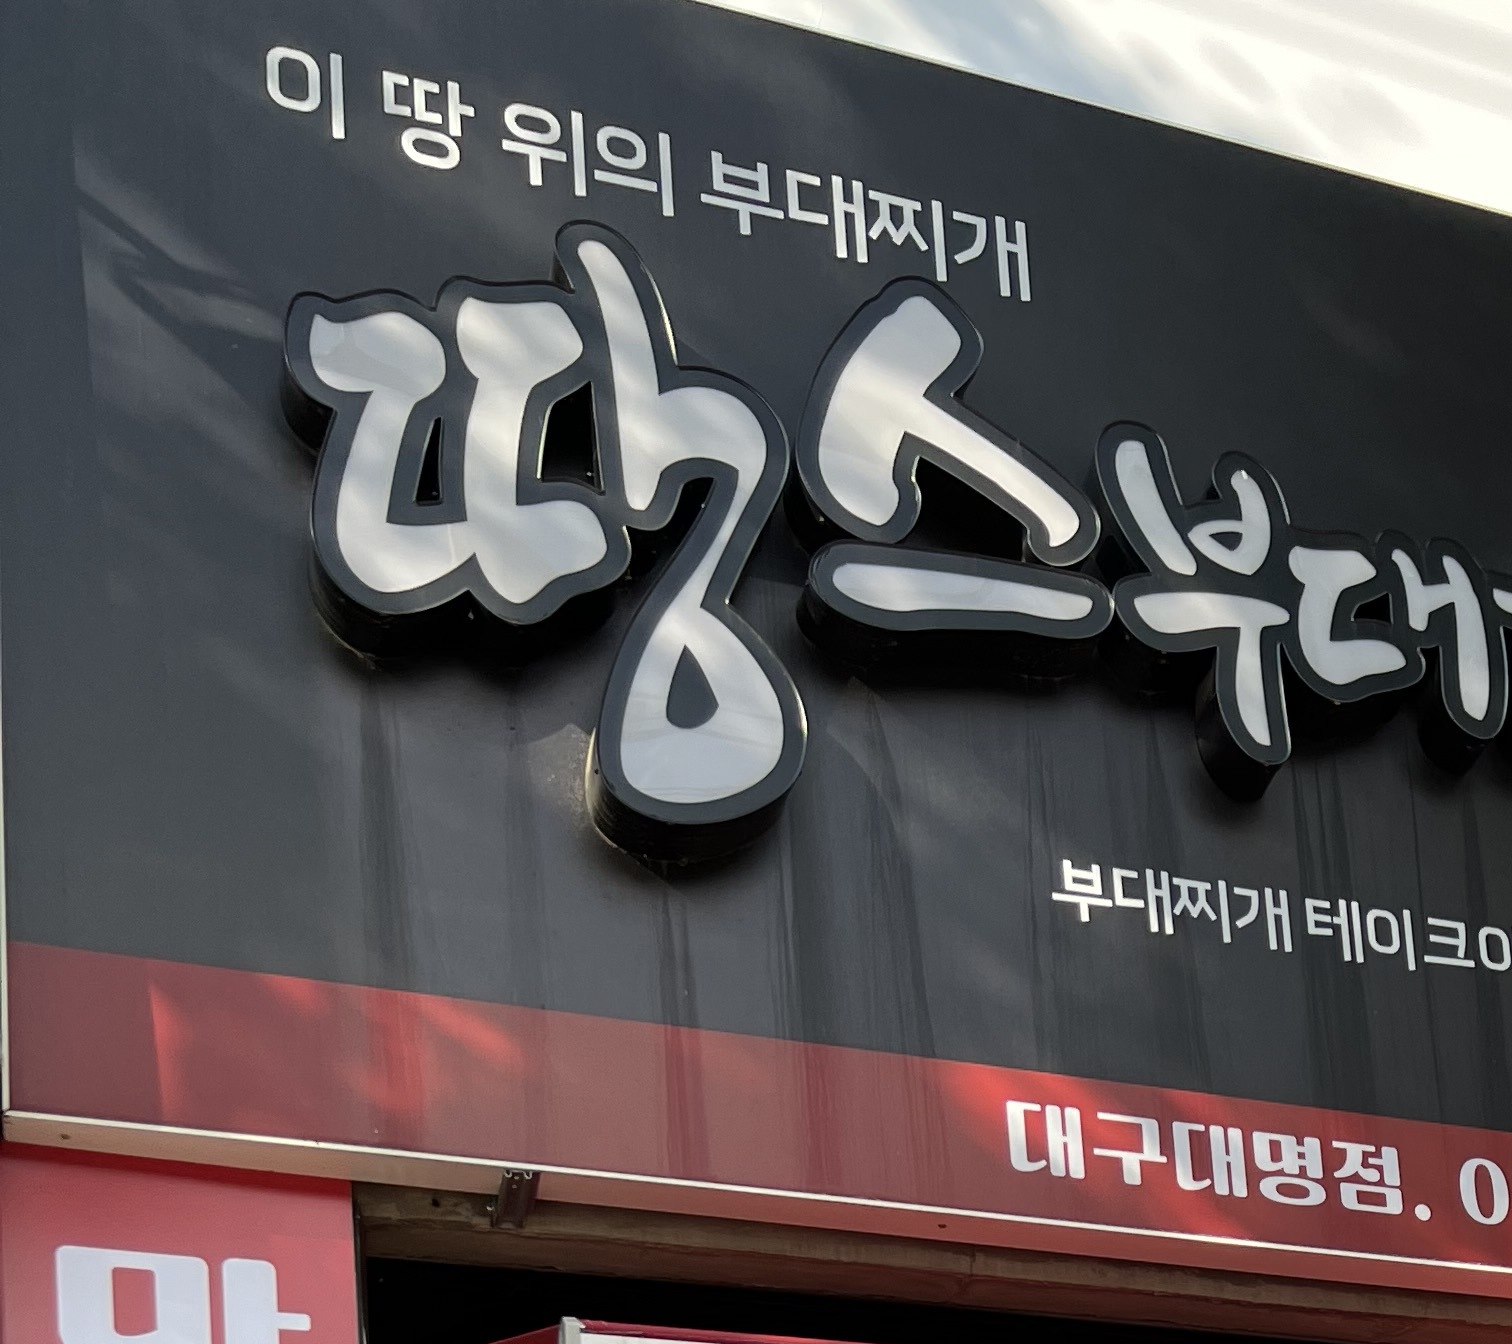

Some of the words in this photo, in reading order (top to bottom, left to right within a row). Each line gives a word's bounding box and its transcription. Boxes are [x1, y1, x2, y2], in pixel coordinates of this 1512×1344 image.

[265, 47, 346, 138] 이
[382, 70, 475, 169] 땅
[501, 102, 676, 216] 위의
[699, 150, 1032, 302] 부대찌개
[1051, 858, 1294, 953] 부대찌개
[1004, 1099, 1433, 1222] 대구대명점.
